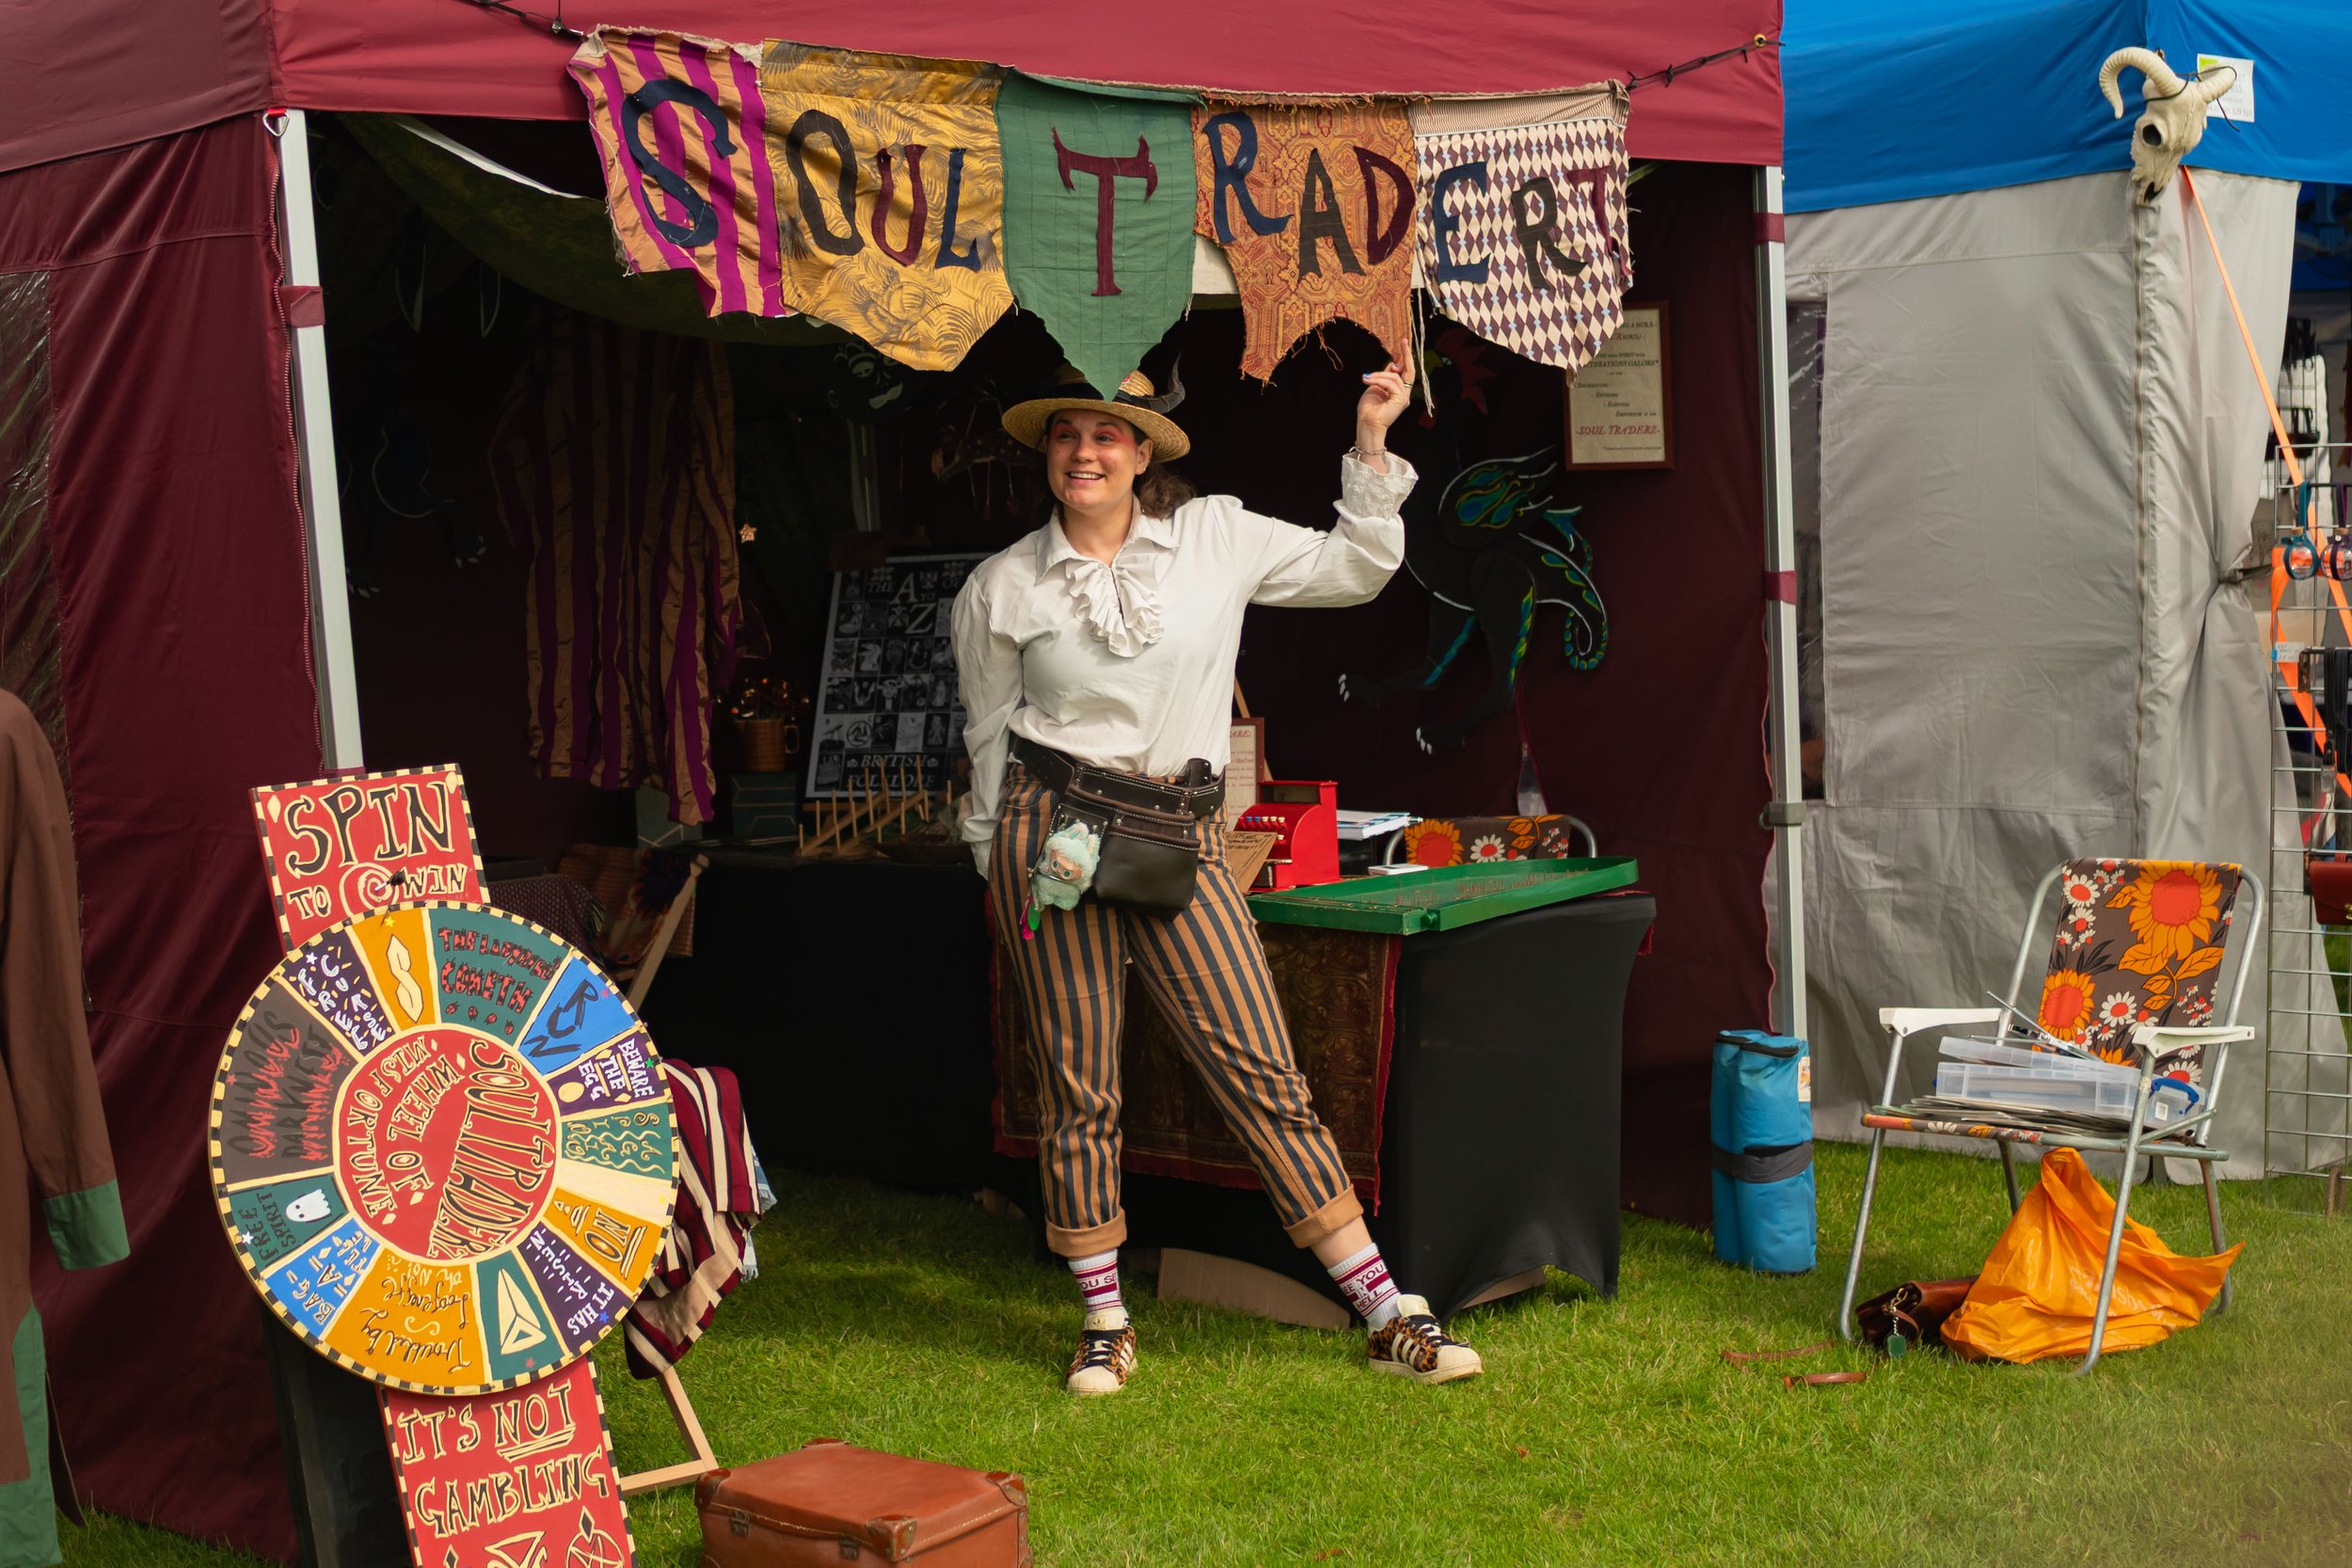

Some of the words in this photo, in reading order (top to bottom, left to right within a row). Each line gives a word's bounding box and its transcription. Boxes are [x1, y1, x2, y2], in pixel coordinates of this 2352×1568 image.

[621, 78, 980, 272] SOUL
[866, 581, 895, 594] THE
[887, 571, 919, 605] A
[904, 602, 937, 635] Z
[860, 753, 928, 768] BRITISH
[283, 781, 454, 879] SPIN
[287, 885, 331, 920] TO
[402, 863, 468, 899] WIN
[437, 926, 480, 952] THE
[297, 968, 369, 1051] FREE
[321, 954, 387, 1041] CURSE
[439, 958, 533, 1014] COMETH
[523, 978, 599, 1059] RUN
[462, 1037, 551, 1135] SOUL
[578, 1059, 605, 1101] EGG
[599, 1054, 626, 1091] THE
[618, 1037, 656, 1099] BEWARE
[387, 1053, 466, 1143] WHEEL
[386, 1149, 435, 1192] OF
[238, 1208, 279, 1261] FREE
[256, 1192, 296, 1249] SPIRIT
[584, 1207, 631, 1263] NO
[530, 1229, 589, 1301] RISEN
[1079, 1278, 1099, 1290] OU
[1343, 1282, 1356, 1294] EE
[1356, 1263, 1385, 1285] YOU
[566, 1302, 599, 1336] HAS
[592, 1281, 615, 1310] IT
[360, 1307, 389, 1355] by
[386, 1330, 472, 1373] Troubled
[397, 1402, 482, 1465] IT'S
[491, 1378, 577, 1447] NOT
[415, 1444, 610, 1539] GAMBLING
